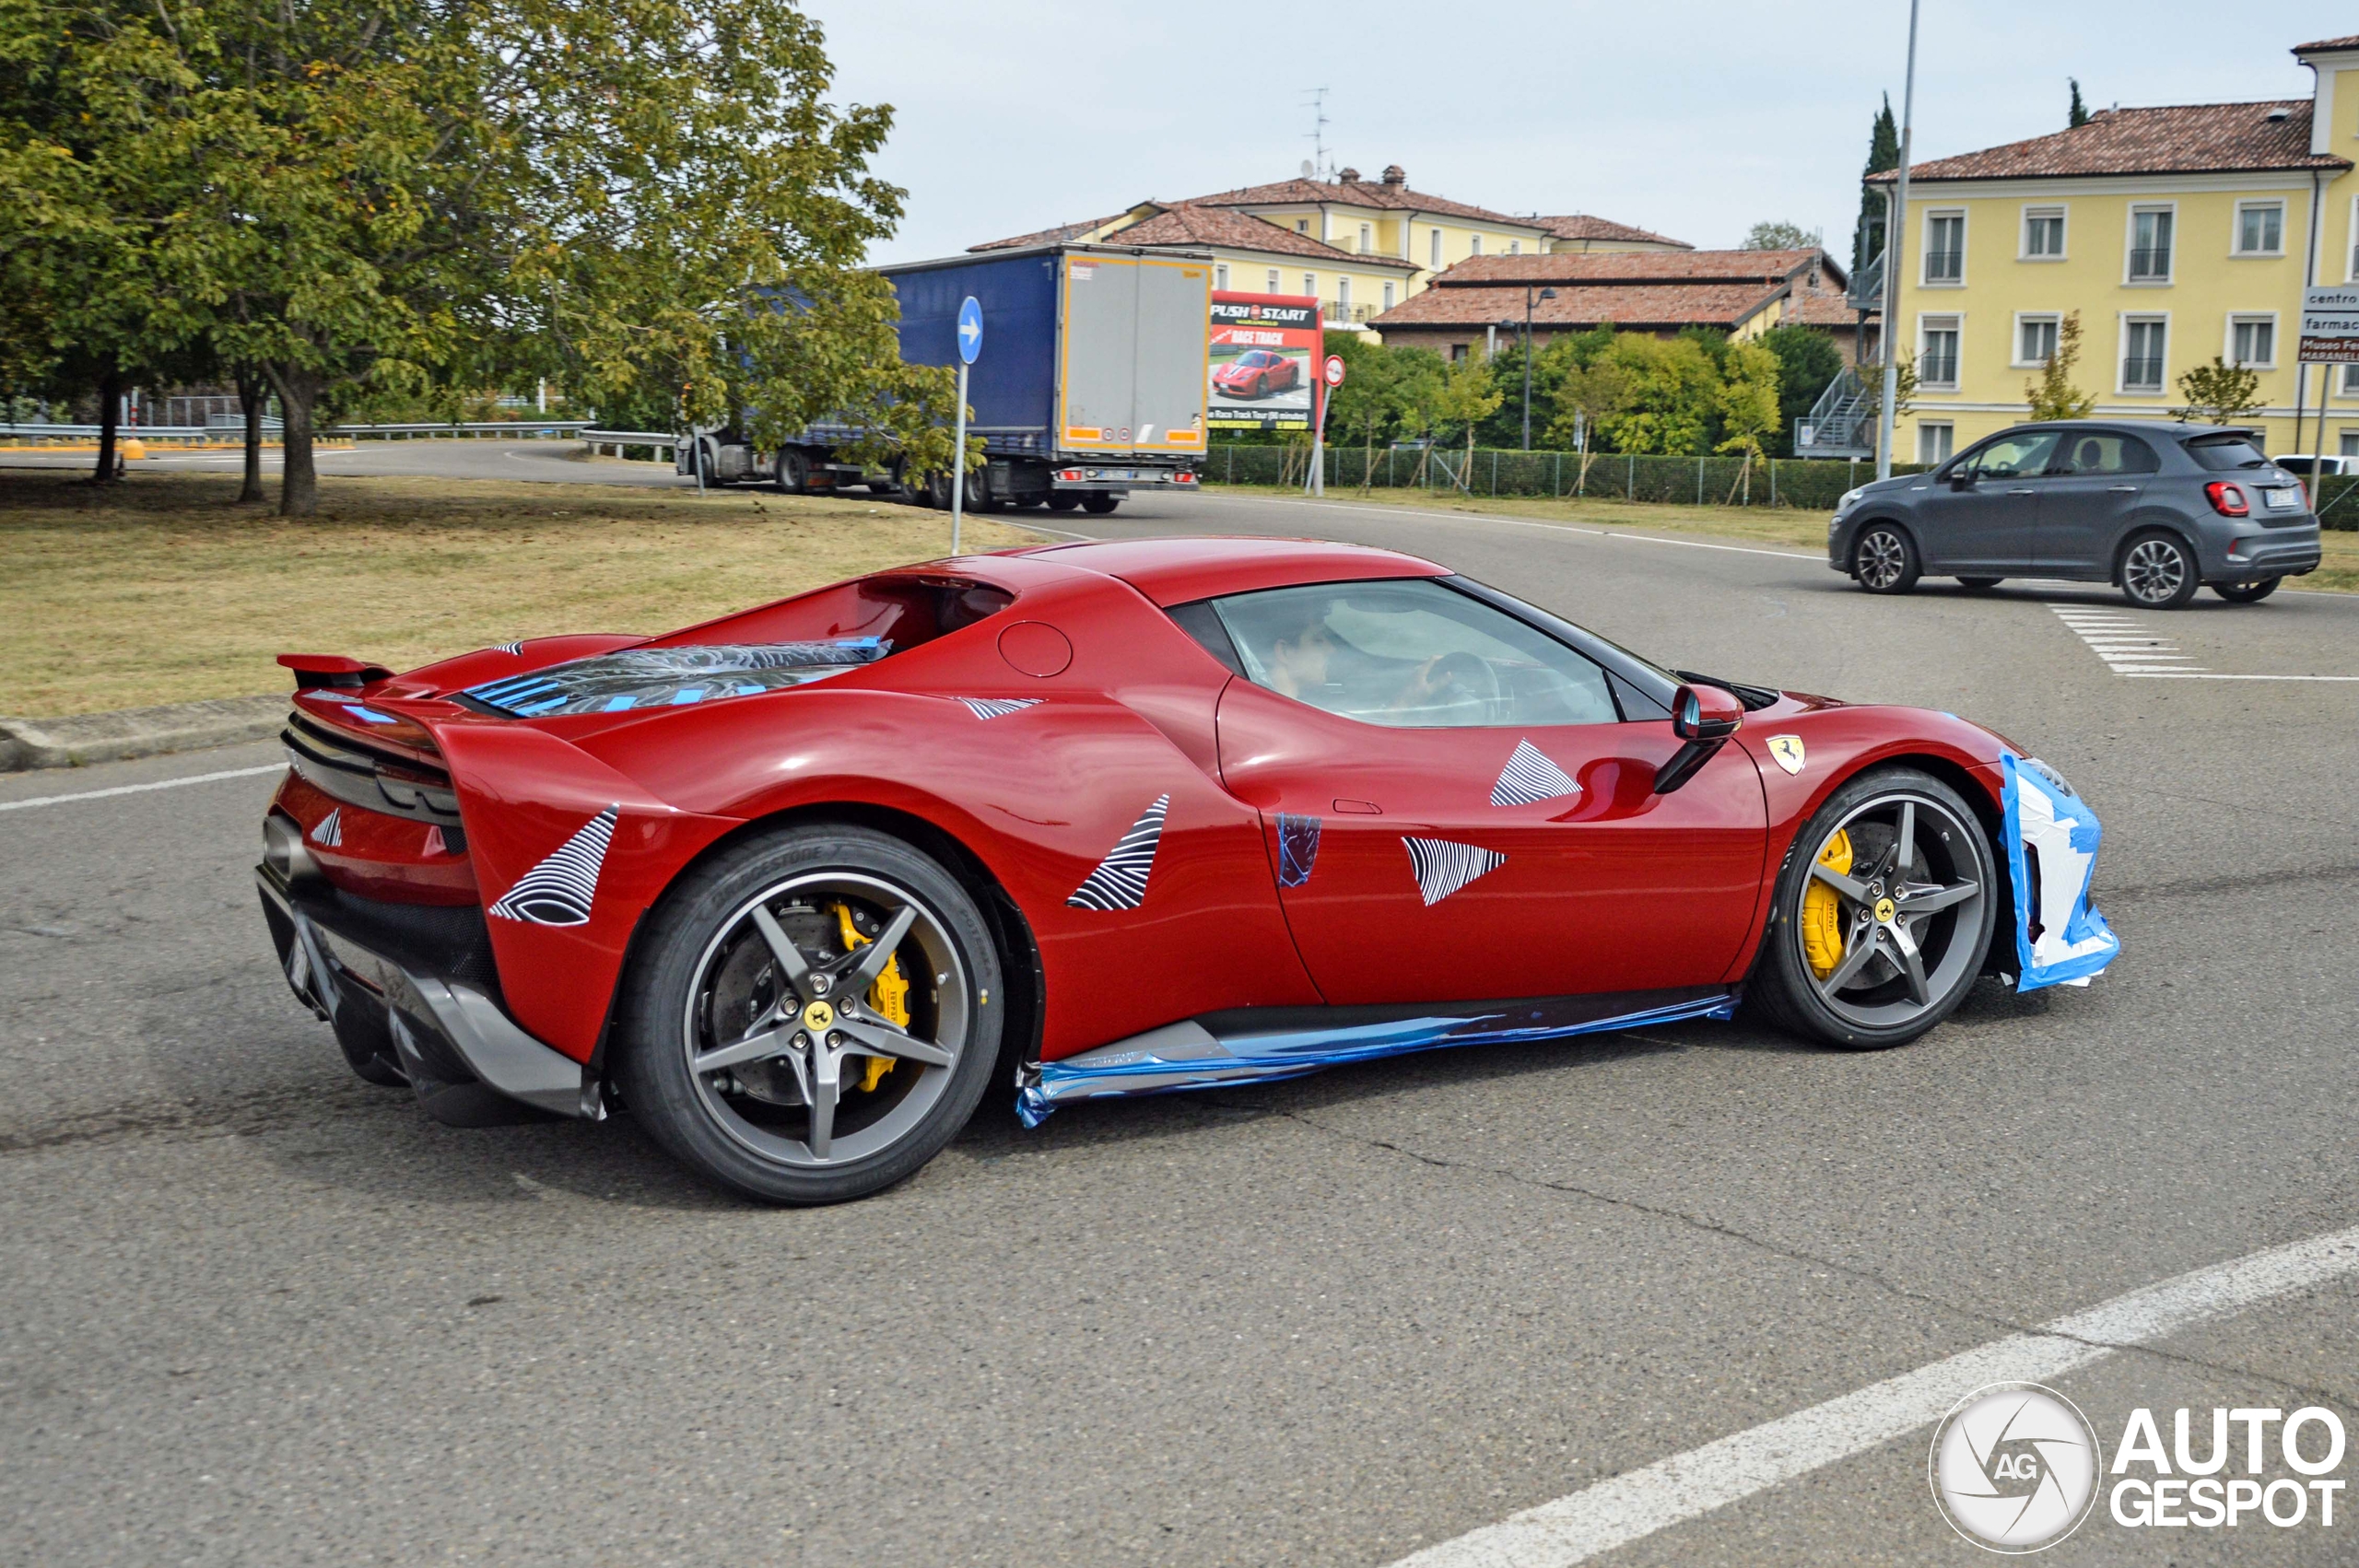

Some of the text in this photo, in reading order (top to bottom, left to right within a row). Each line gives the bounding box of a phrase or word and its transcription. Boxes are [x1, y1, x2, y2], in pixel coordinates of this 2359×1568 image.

[2309, 293, 2357, 304] centro
[1211, 304, 1309, 321] PUSH START
[1231, 330, 1254, 345] RACE
[1254, 331, 1285, 345] TRACK
[2302, 340, 2341, 350] Museo
